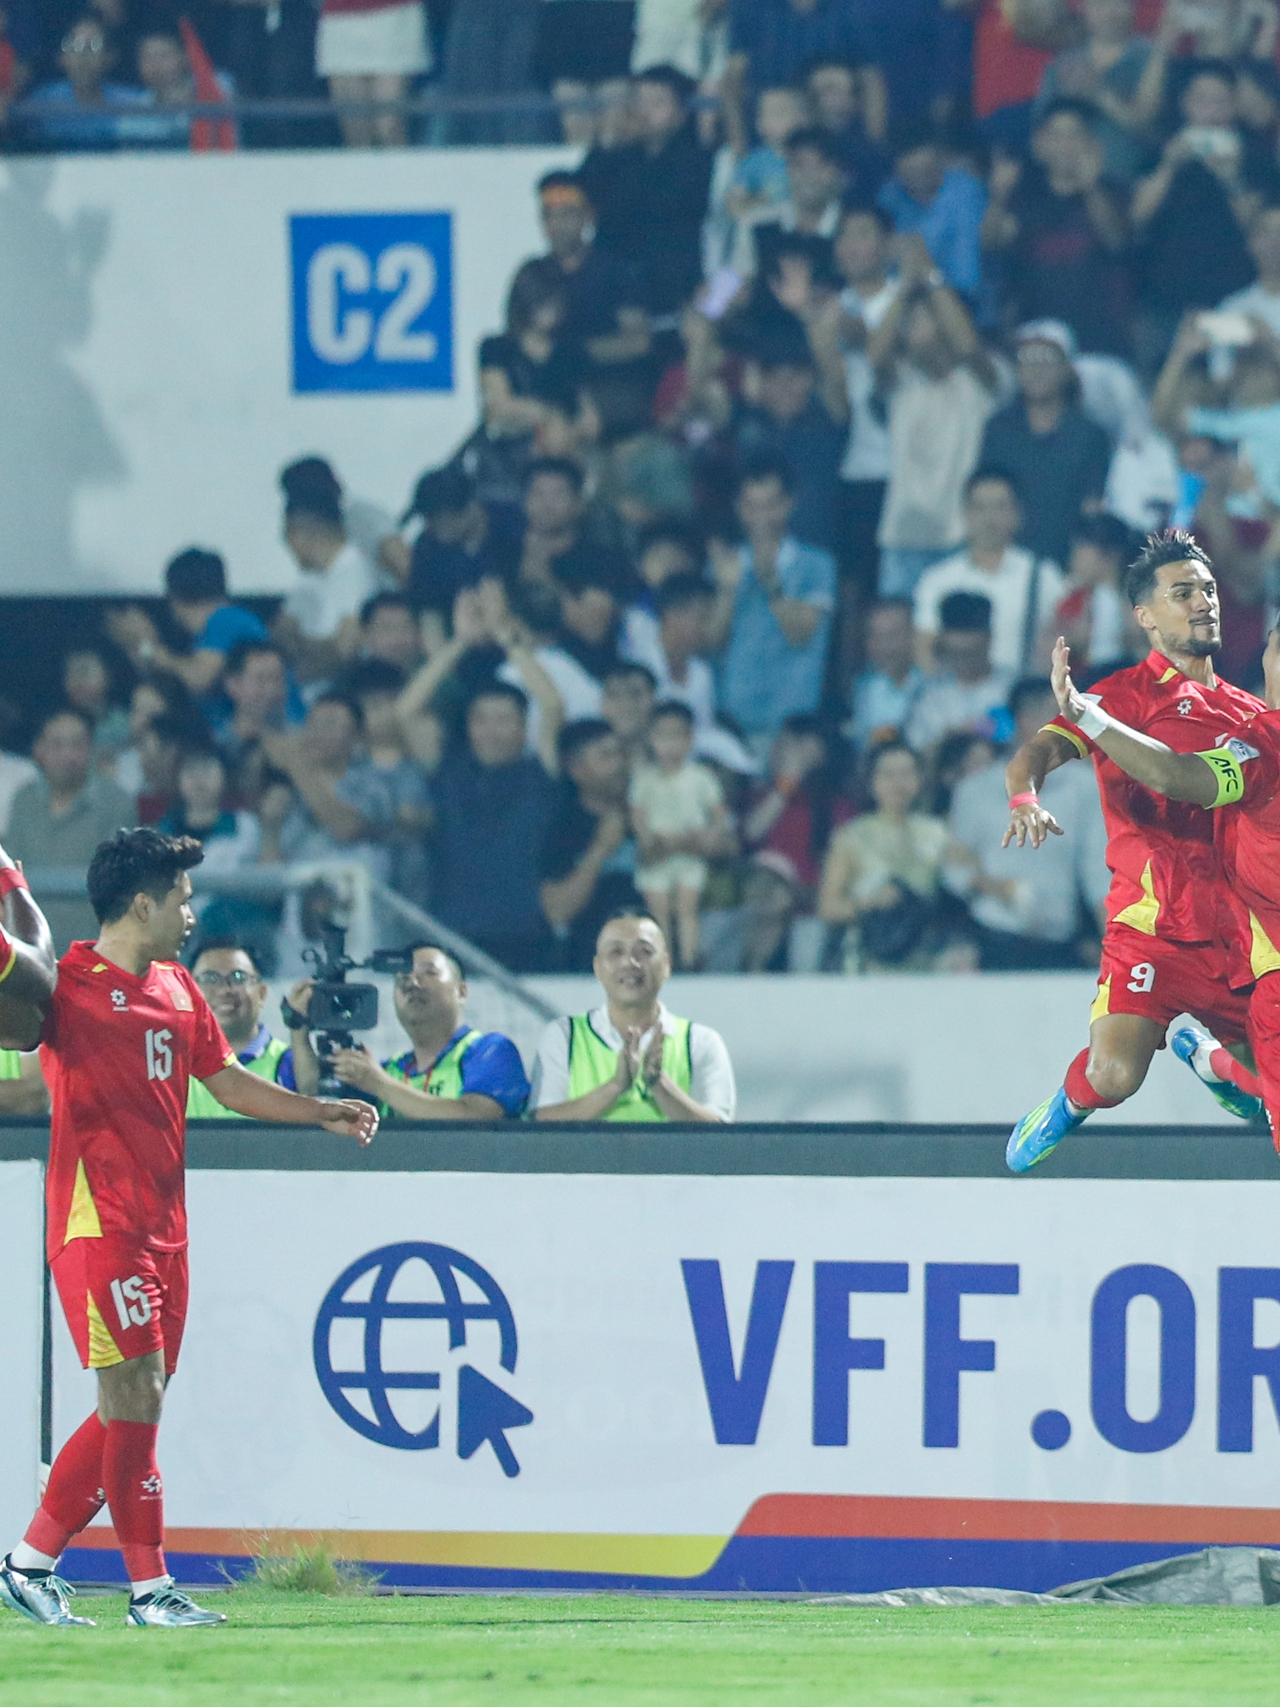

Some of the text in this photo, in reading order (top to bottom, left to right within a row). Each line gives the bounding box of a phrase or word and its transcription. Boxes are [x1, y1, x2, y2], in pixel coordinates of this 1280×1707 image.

[306, 242, 438, 364] C2
[1208, 755, 1239, 793] AFC
[1126, 961, 1156, 993] 9
[144, 1028, 173, 1082] 15
[109, 1274, 153, 1331] 15
